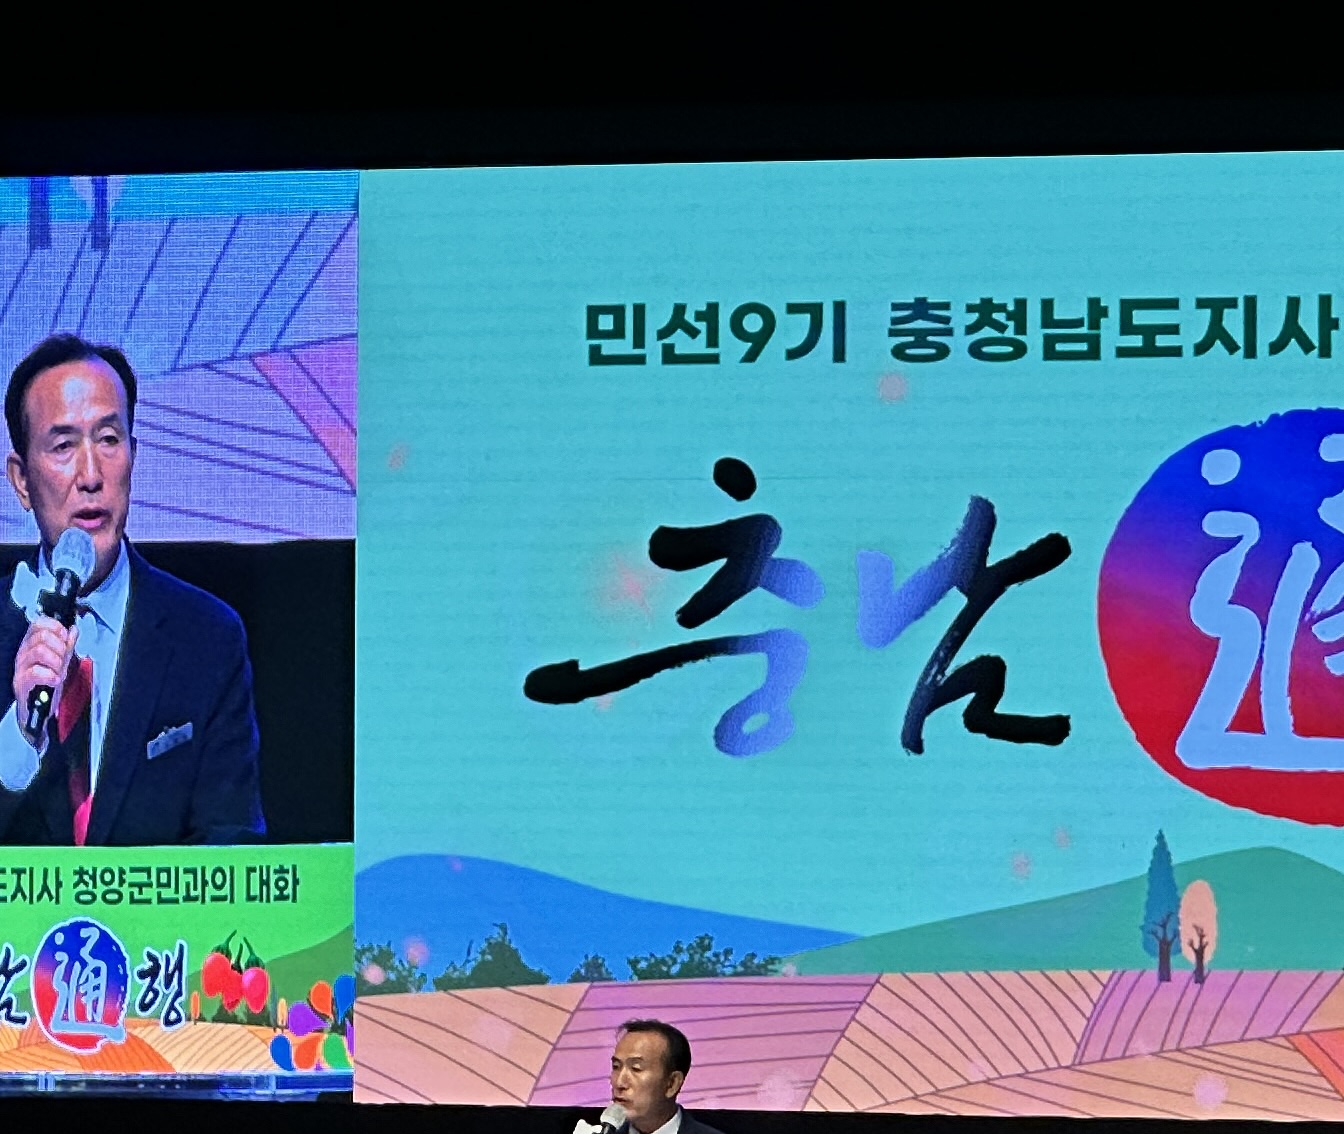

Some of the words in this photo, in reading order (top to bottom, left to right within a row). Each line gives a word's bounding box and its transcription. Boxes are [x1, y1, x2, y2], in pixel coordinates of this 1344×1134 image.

[585, 300, 848, 368] 민선9기
[887, 295, 1340, 363] 충청남도지사
[524, 458, 1070, 757] 충남
[73, 865, 235, 904] 청양군민과의
[246, 866, 299, 903] 대화
[138, 941, 186, 1024] 행
